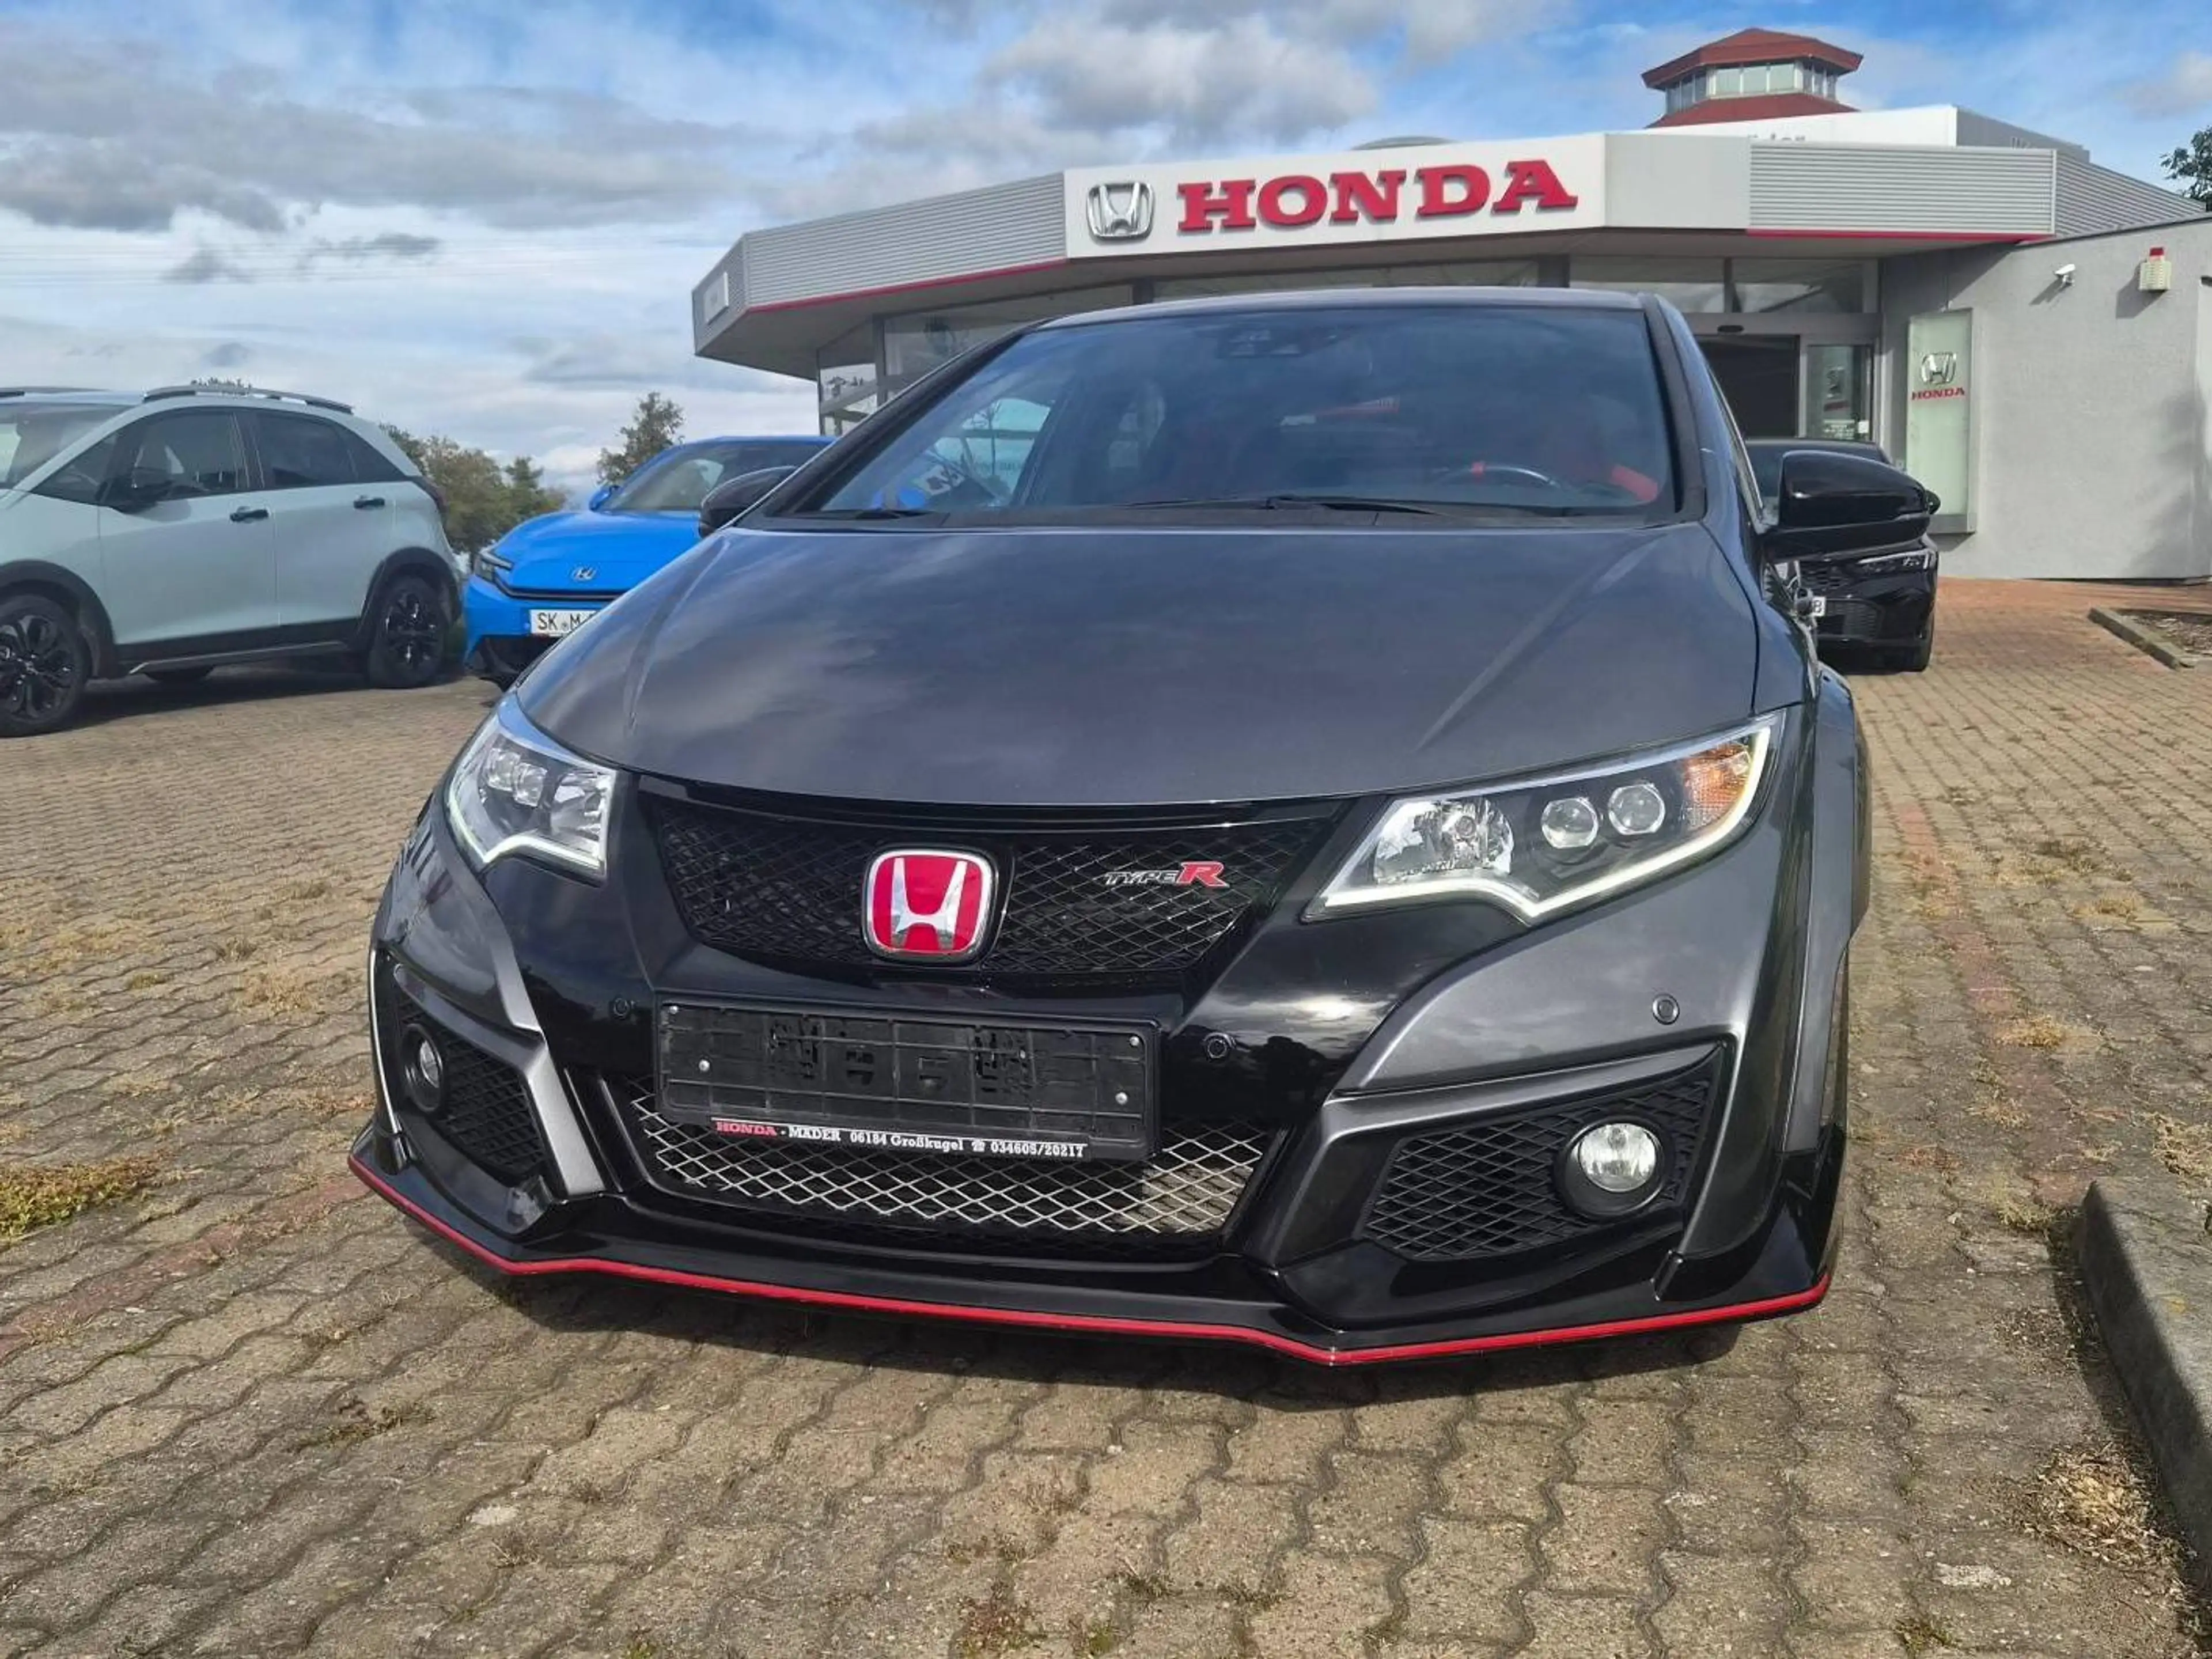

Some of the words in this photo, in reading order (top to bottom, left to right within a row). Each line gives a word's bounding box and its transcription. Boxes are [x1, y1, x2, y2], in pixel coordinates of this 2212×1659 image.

[1177, 160, 1578, 232] HONDA
[1912, 387, 1965, 400] HONDA
[537, 612, 558, 631] SK
[1105, 870, 1179, 885] TYPE
[1177, 861, 1230, 888] R
[717, 1121, 777, 1137] HONDA
[789, 1125, 841, 1142] MADER
[850, 1131, 887, 1146] 06184
[891, 1135, 964, 1153] Großkugel
